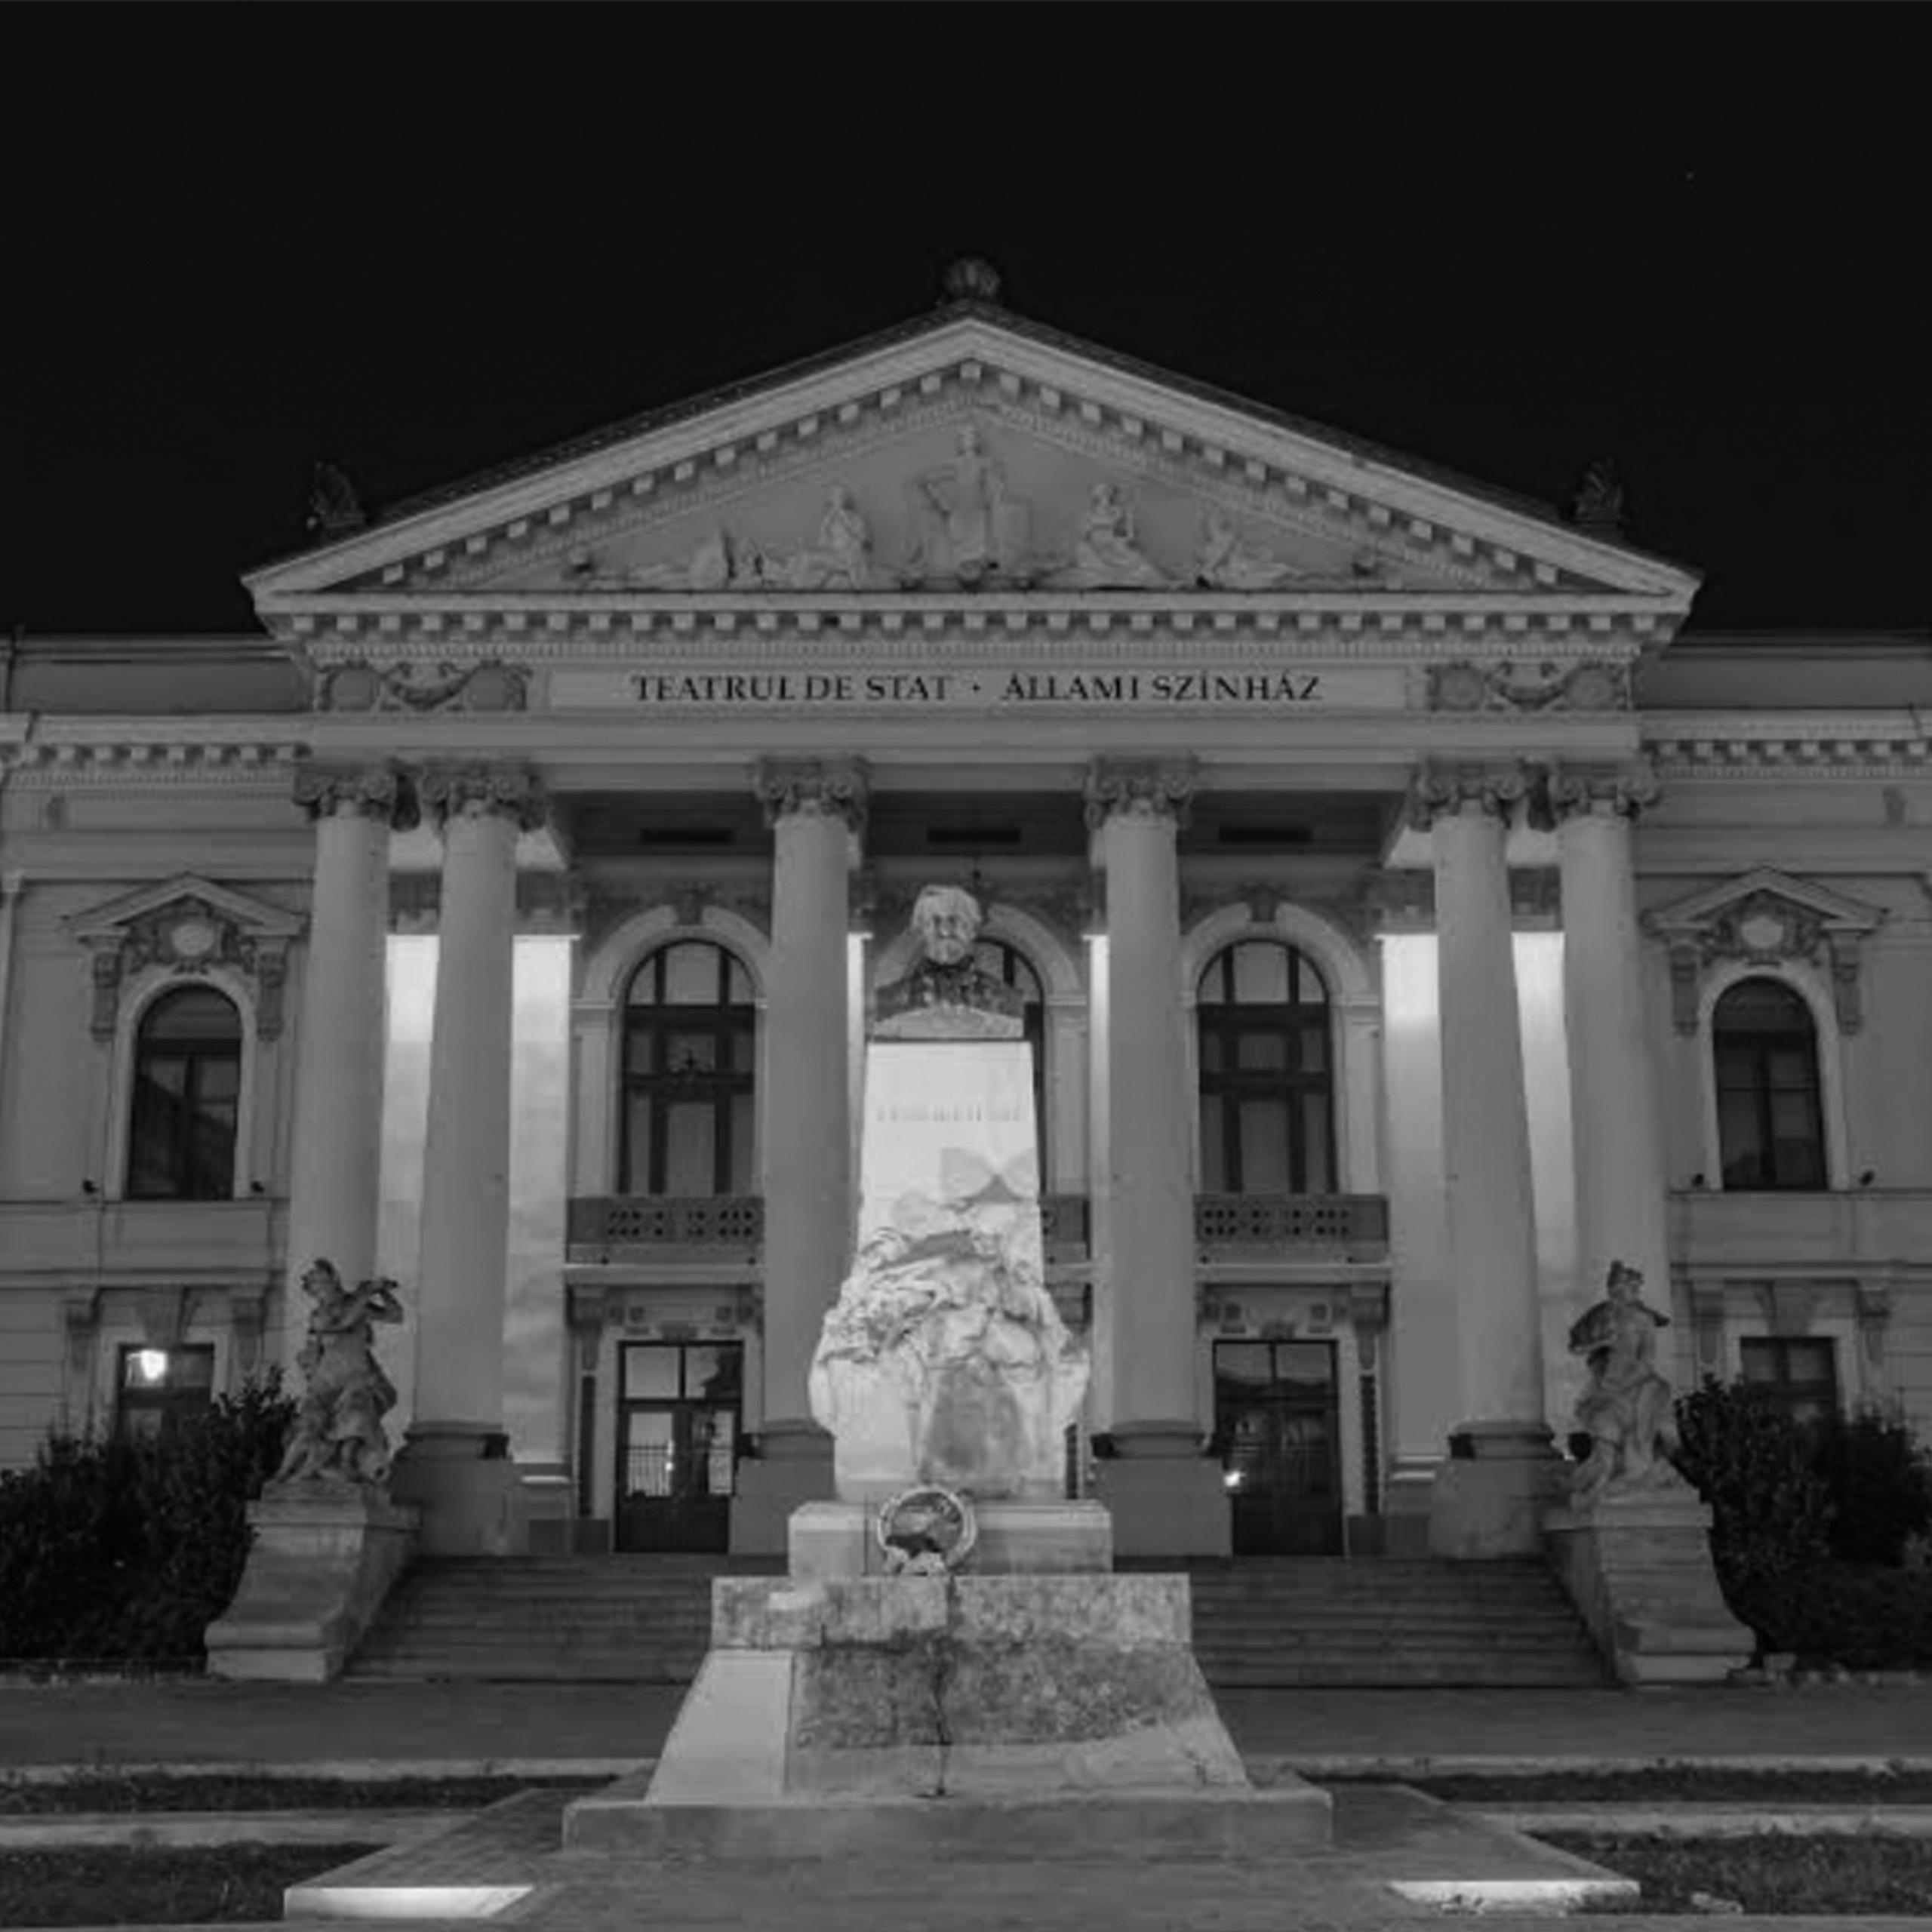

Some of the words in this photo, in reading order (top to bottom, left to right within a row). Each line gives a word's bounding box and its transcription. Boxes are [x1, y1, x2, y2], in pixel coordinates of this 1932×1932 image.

[632, 675, 795, 701] TEATRUL
[804, 675, 853, 701] DE
[866, 675, 951, 701] STAT
[1001, 671, 1139, 701] ÁLLAMI
[1151, 669, 1322, 701] SZÍNHÁZ
